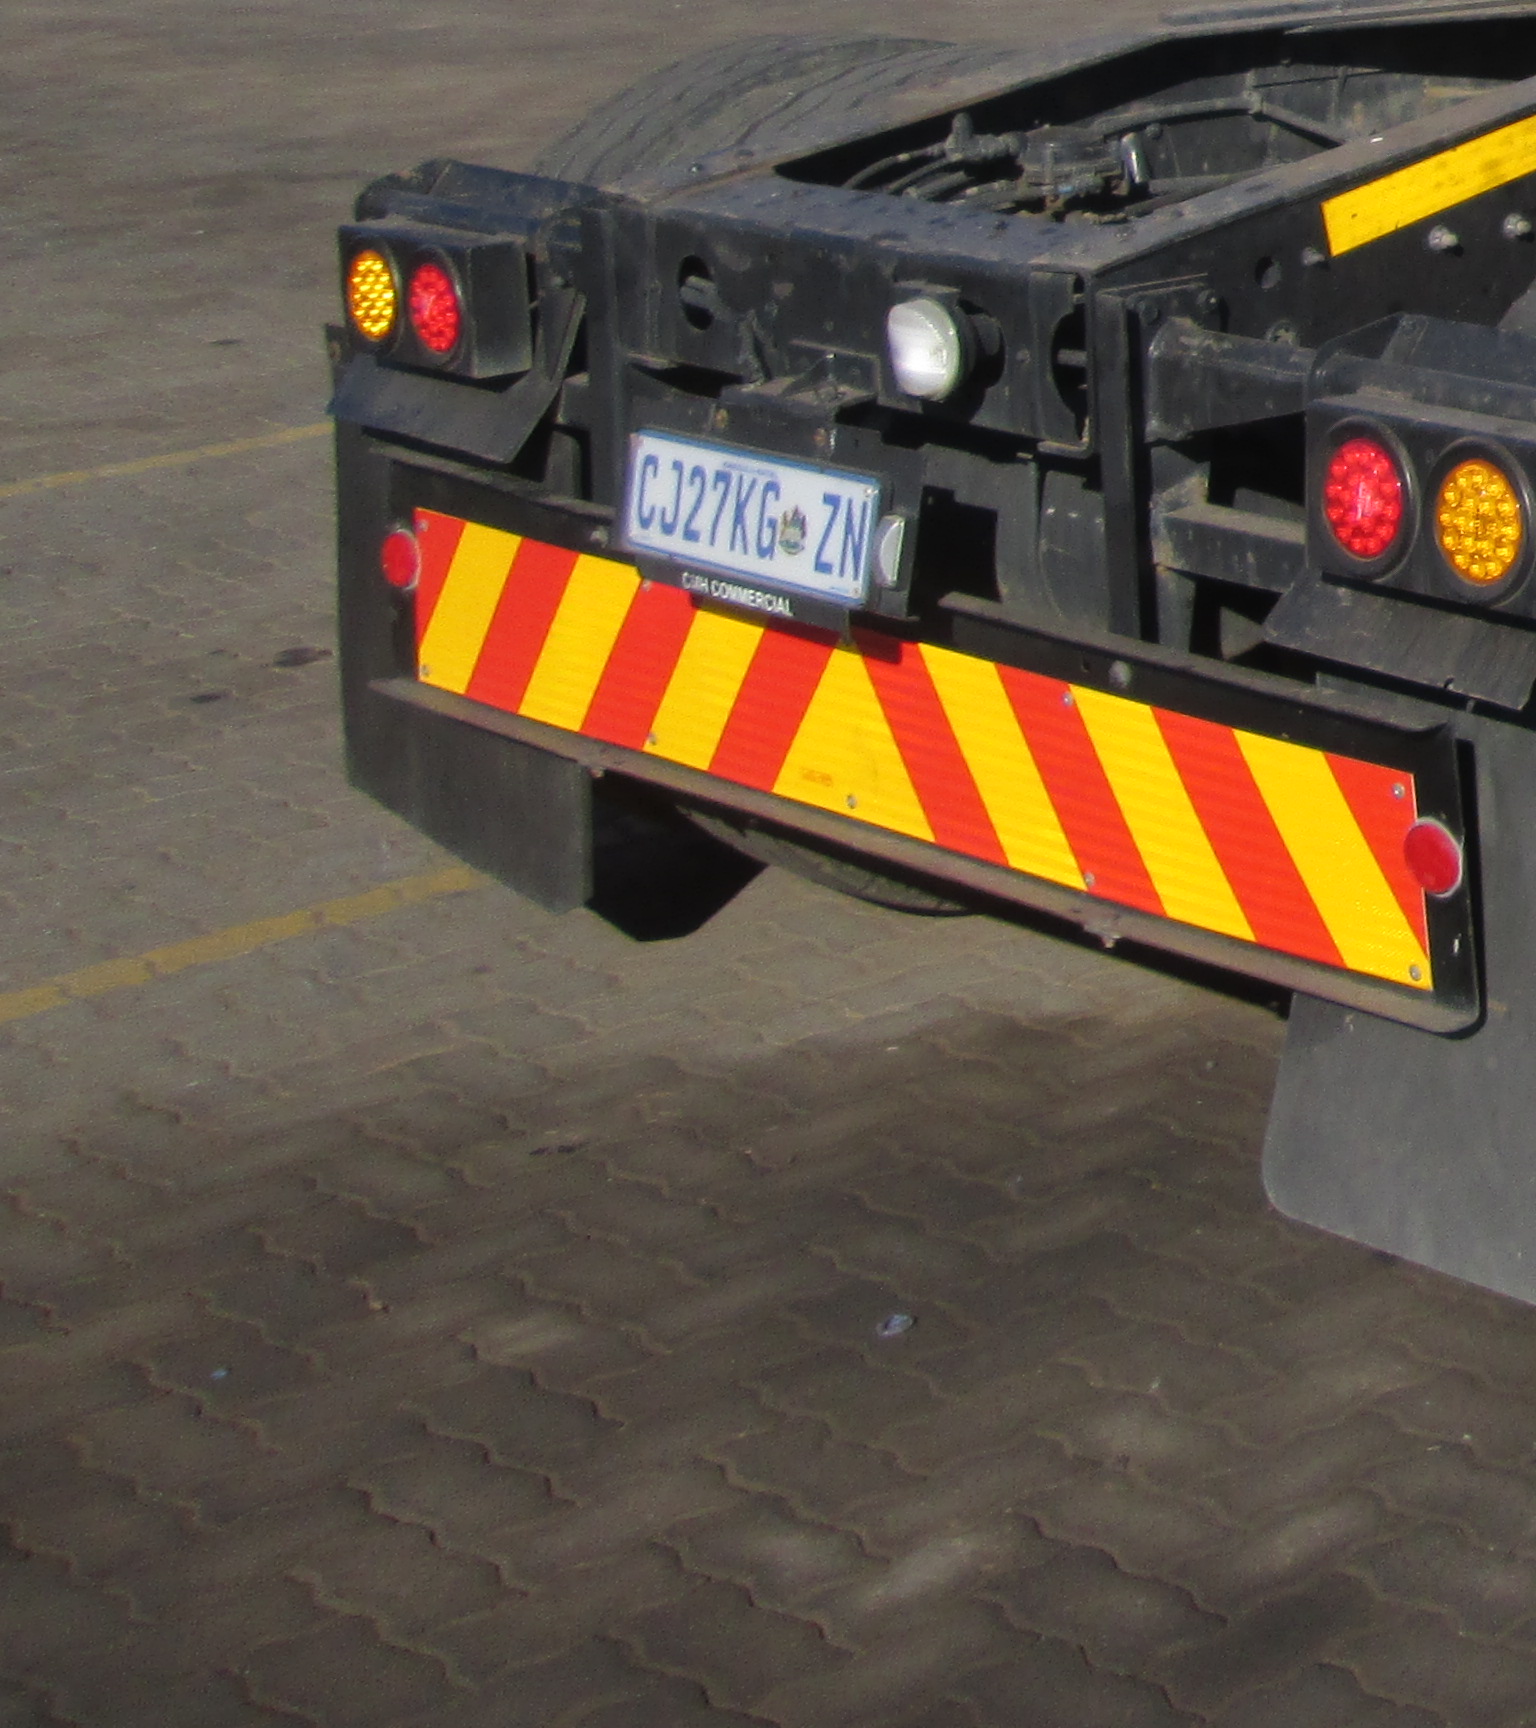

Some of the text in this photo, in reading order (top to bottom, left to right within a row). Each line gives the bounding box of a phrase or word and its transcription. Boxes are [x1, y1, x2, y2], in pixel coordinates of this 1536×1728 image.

[637, 454, 869, 582] CJ27KG ZN
[710, 578, 794, 617] COMMERCIAL
